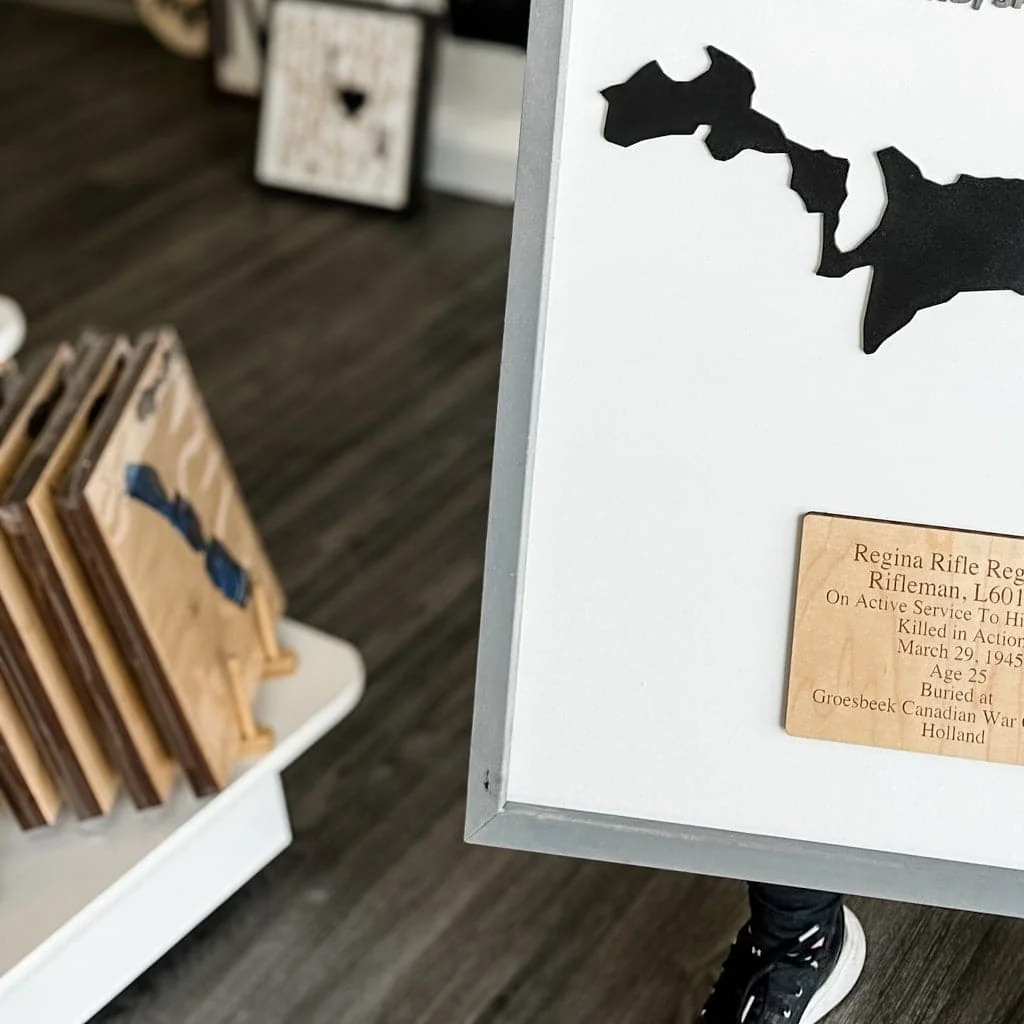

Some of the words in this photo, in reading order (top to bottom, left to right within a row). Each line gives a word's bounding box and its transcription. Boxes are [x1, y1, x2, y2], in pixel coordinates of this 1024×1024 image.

[854, 543, 924, 570] Regina
[930, 553, 980, 576] Rifle
[868, 571, 968, 601] Rifleman,
[825, 589, 850, 606] On
[854, 594, 908, 614] Active
[912, 600, 973, 622] Service
[977, 608, 1000, 624] To
[897, 619, 948, 639] Killed
[952, 625, 968, 642] in
[897, 639, 950, 660] March
[953, 645, 980, 664] 29,
[985, 650, 1024, 668] 1945
[929, 664, 963, 682] Age
[967, 668, 988, 683] 25
[920, 682, 975, 703] Buried
[978, 690, 994, 705] at
[811, 688, 897, 714] Groesbeek
[901, 700, 977, 724] Canadian
[982, 711, 1018, 729] War
[921, 723, 986, 745] Holland
